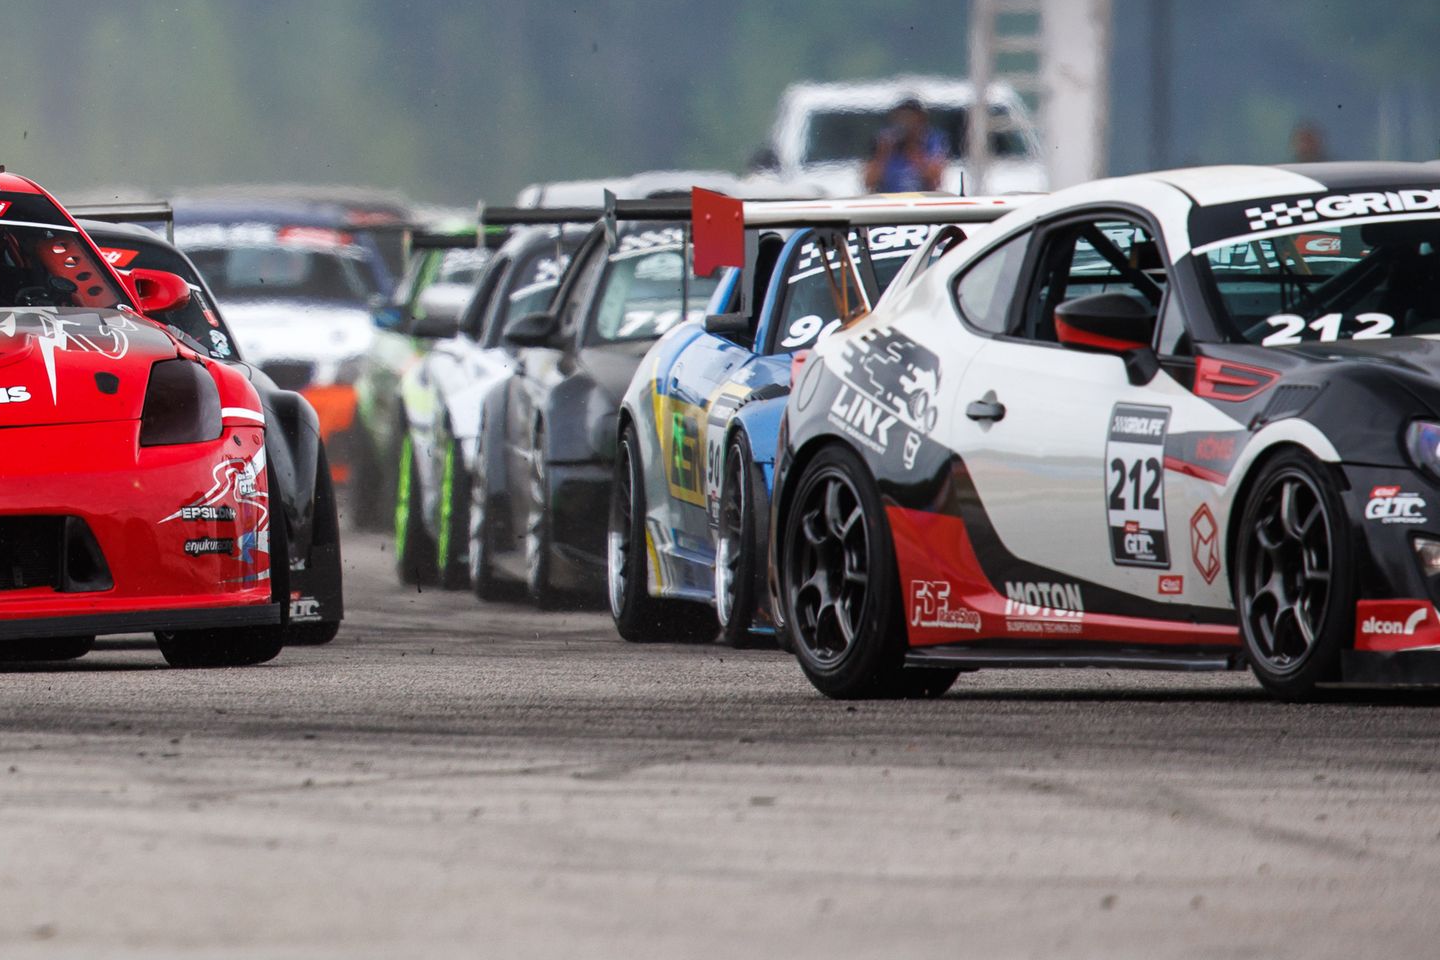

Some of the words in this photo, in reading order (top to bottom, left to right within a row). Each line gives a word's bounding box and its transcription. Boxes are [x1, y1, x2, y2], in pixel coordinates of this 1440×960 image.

[1315, 189, 1440, 218] GRID
[1262, 312, 1395, 347] 212
[830, 383, 899, 447] LINK
[1109, 457, 1162, 511] 212
[1005, 581, 1085, 618] MOTON
[1361, 615, 1404, 634] alcon
